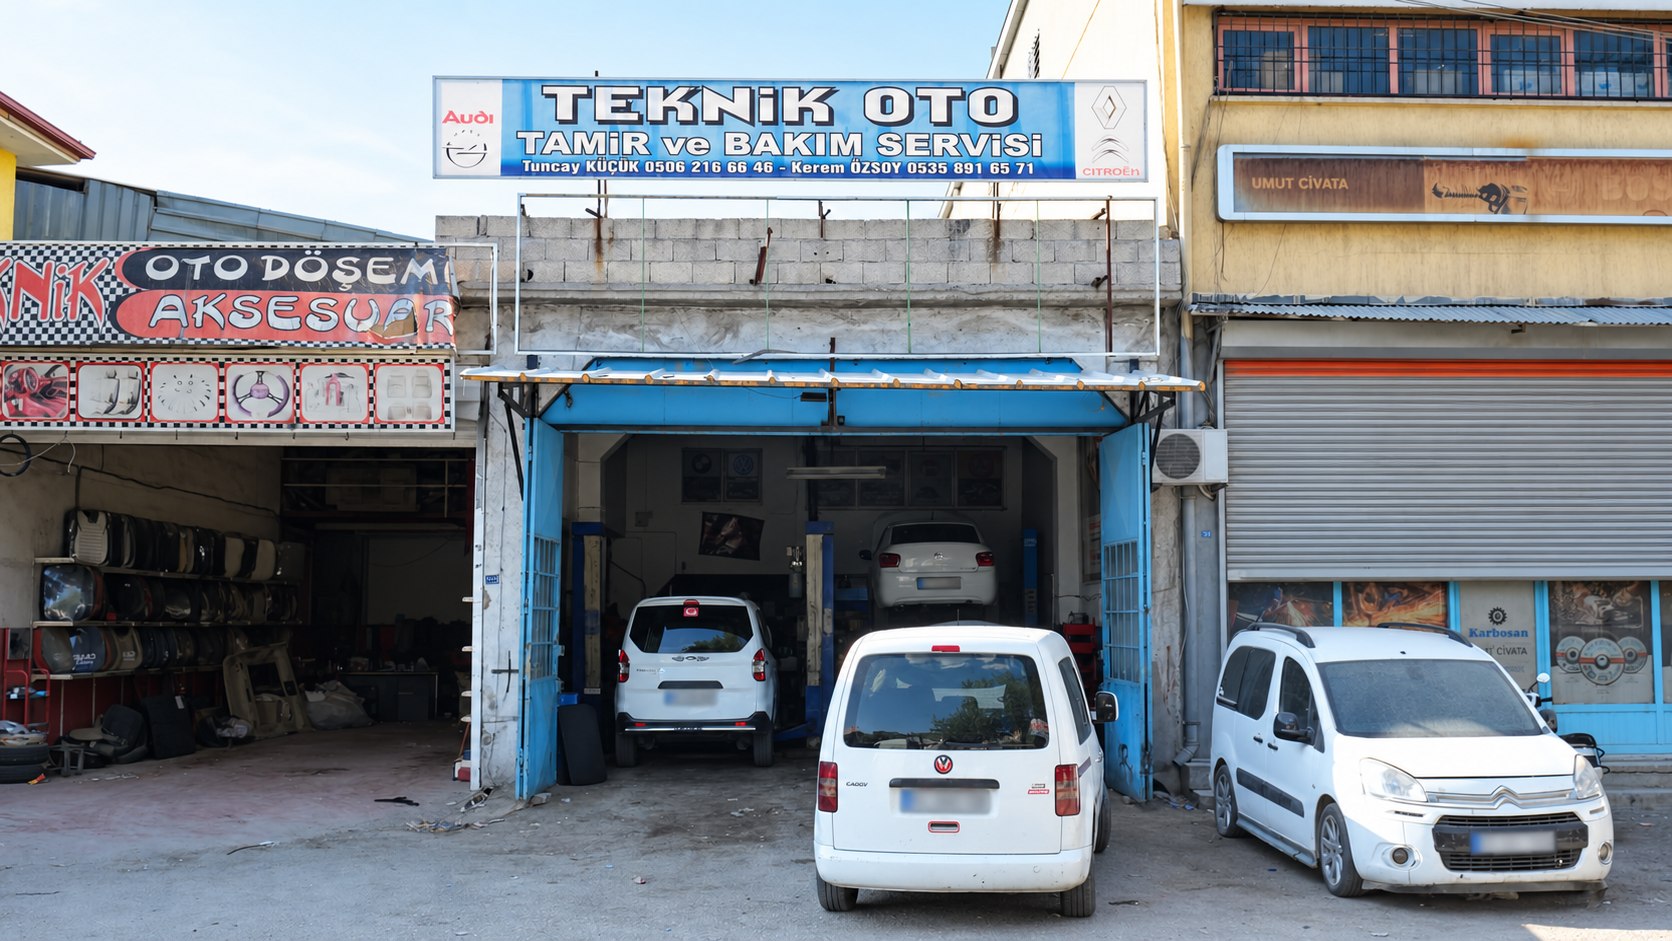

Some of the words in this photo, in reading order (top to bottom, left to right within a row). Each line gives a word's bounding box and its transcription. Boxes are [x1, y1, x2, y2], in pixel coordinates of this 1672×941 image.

[863, 85, 1019, 127] OTO
[661, 136, 710, 156] ve
[723, 132, 863, 157] BAKIM
[522, 160, 578, 175] Tuncay
[586, 156, 639, 175] KÜÇÜK
[645, 160, 685, 174] 0506
[691, 160, 721, 174] 216
[726, 160, 747, 174] 66
[752, 160, 774, 174] 46
[791, 161, 845, 175] Kerem
[850, 157, 901, 175] ÖZSOY
[907, 162, 948, 175] 0535
[954, 162, 982, 175] 891
[989, 162, 1010, 175] 65
[1016, 162, 1034, 175] 71
[1251, 177, 1296, 190] UMUT
[1298, 175, 1349, 190] CİVATA
[145, 254, 249, 281] OTO
[1468, 628, 1529, 638] Karbosan
[1496, 645, 1528, 655] CİVATA
